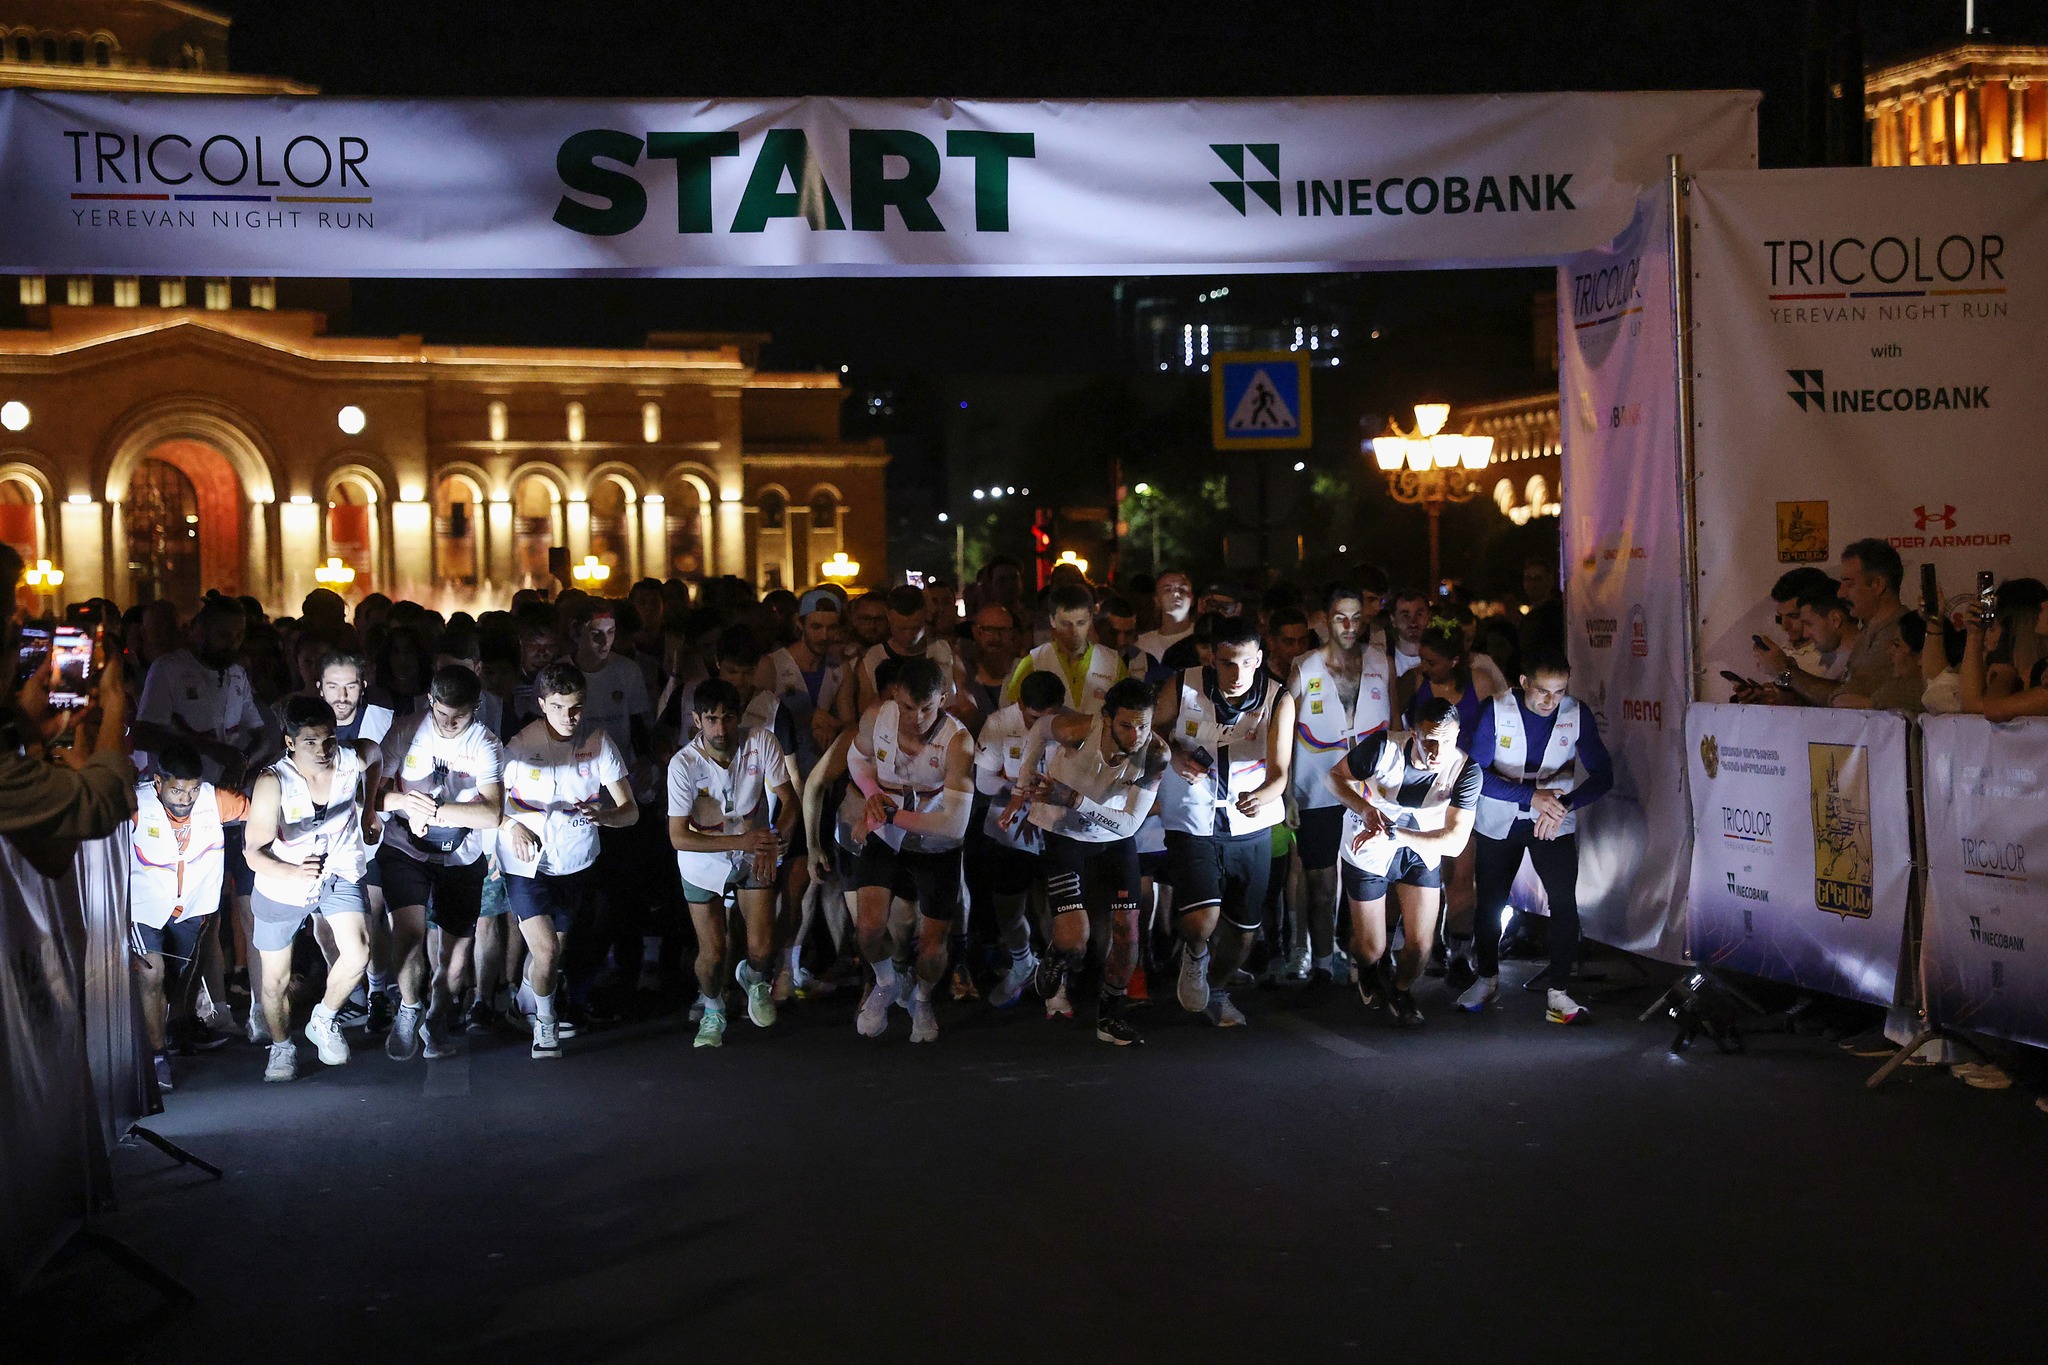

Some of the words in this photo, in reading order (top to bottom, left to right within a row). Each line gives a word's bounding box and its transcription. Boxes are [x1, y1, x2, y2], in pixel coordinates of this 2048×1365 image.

[63, 130, 371, 188] TRICOLOR
[552, 128, 1036, 237] START
[1296, 173, 1577, 217] INECOBANK
[72, 208, 195, 228] YEREVAN
[212, 210, 302, 229] NIGHT
[318, 210, 375, 230] RUN
[1763, 234, 2006, 287] TRICOLOR
[1770, 306, 1866, 324] YEREVAN
[1879, 303, 1950, 322] NIGHT
[1963, 302, 2008, 318] RUN
[1871, 343, 1903, 358] with
[1832, 385, 1990, 414] INECOBANK
[1929, 533, 2012, 548] ARMOUR
[1623, 700, 1662, 730] menq
[1096, 812, 1121, 830] TERREX
[1722, 806, 1772, 837] TRICOLOR
[1961, 838, 2026, 874] TRICOLOR
[1736, 883, 1769, 902] INECOBANK
[1981, 931, 2025, 951] INECOBANK
